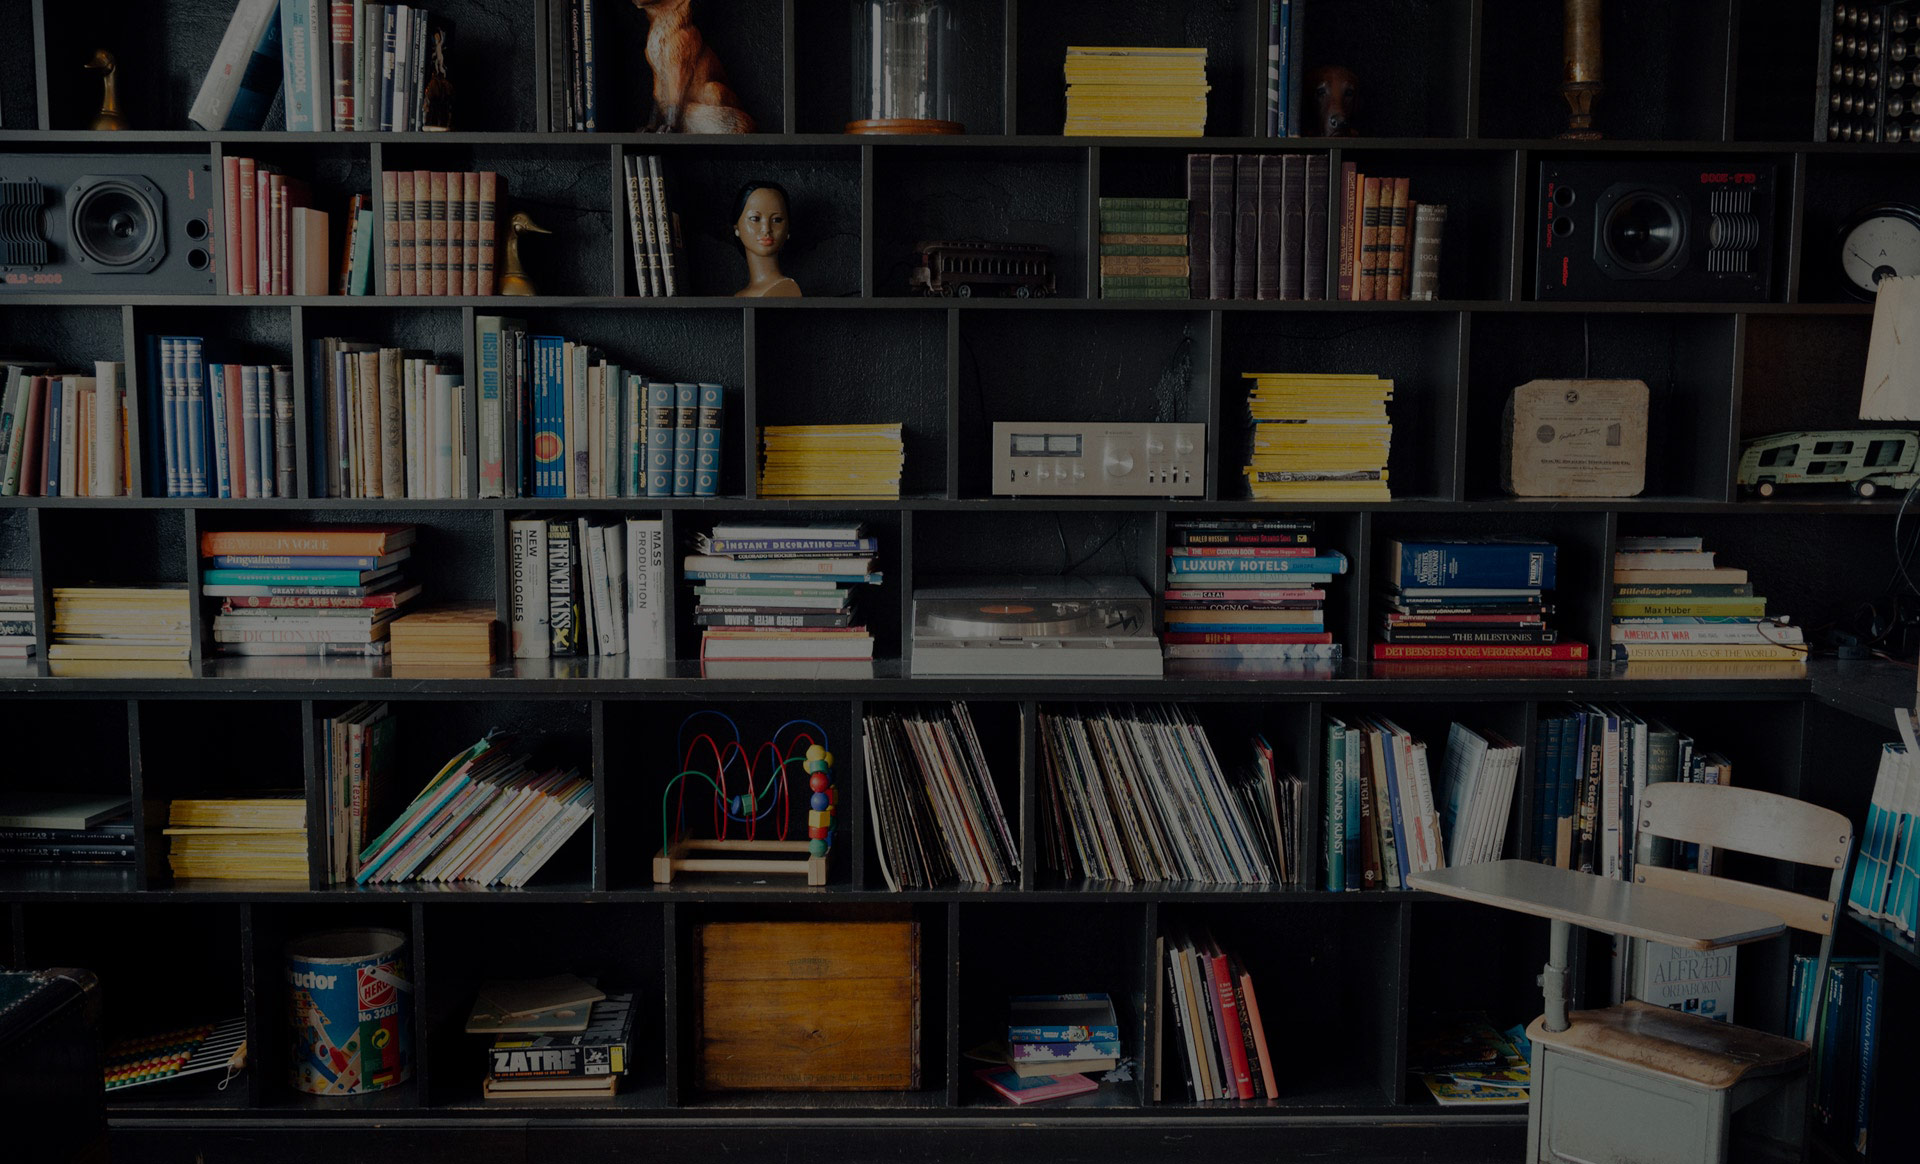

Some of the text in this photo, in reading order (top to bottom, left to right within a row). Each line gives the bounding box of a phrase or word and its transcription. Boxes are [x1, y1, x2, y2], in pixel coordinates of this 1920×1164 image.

[292, 27, 306, 92] HANDBOOK
[1348, 171, 1356, 189] EIGHT
[277, 538, 287, 549] IN
[288, 538, 329, 550] VOGUE
[529, 529, 537, 557] NEW
[653, 530, 661, 566] MASS
[773, 541, 833, 550] DECORATING
[1189, 535, 1208, 543] KHALED
[1192, 547, 1202, 555] THE
[1240, 548, 1255, 556] BOOK
[549, 539, 570, 593] FRENCH
[638, 530, 647, 609] PRODUCTION
[1182, 560, 1235, 571] LUXURY
[1240, 560, 1289, 571] HOTELS
[1530, 553, 1540, 585] TRIDENT
[513, 529, 523, 622] TECHNOLOGIES
[697, 572, 719, 580] GIANTS
[719, 572, 727, 580] OF
[728, 572, 738, 580] THE
[271, 587, 294, 595] GREAT
[1618, 587, 1693, 597] Billedkogebogen
[270, 597, 364, 607] ATLAS OF THE WORLD
[1644, 606, 1691, 614] Max Huber
[550, 596, 571, 629] KISS
[243, 630, 335, 643] DICTIONARY
[1453, 633, 1473, 641] THE
[1474, 633, 1532, 642] MILESTONES
[1624, 630, 1690, 641] AMERICA AT WAR
[1385, 647, 1552, 658] DET BEDSTES STORE VERDENSATLAS
[1631, 648, 1778, 658] USTRATED ATLAS OF THE WORLD
[1418, 757, 1432, 813] REFLECTIONS
[1582, 744, 1600, 841] Saint Petersburg
[352, 784, 362, 817] lesum
[1360, 776, 1370, 817] FUGLAR
[1333, 759, 1344, 855] GRØNLANDS KUNST
[358, 1012, 372, 1022] No
[1242, 1027, 1256, 1050] SKIP
[493, 1049, 576, 1073] ZATRE
[1857, 996, 1874, 1123] CULINA MEDITERRANEA
